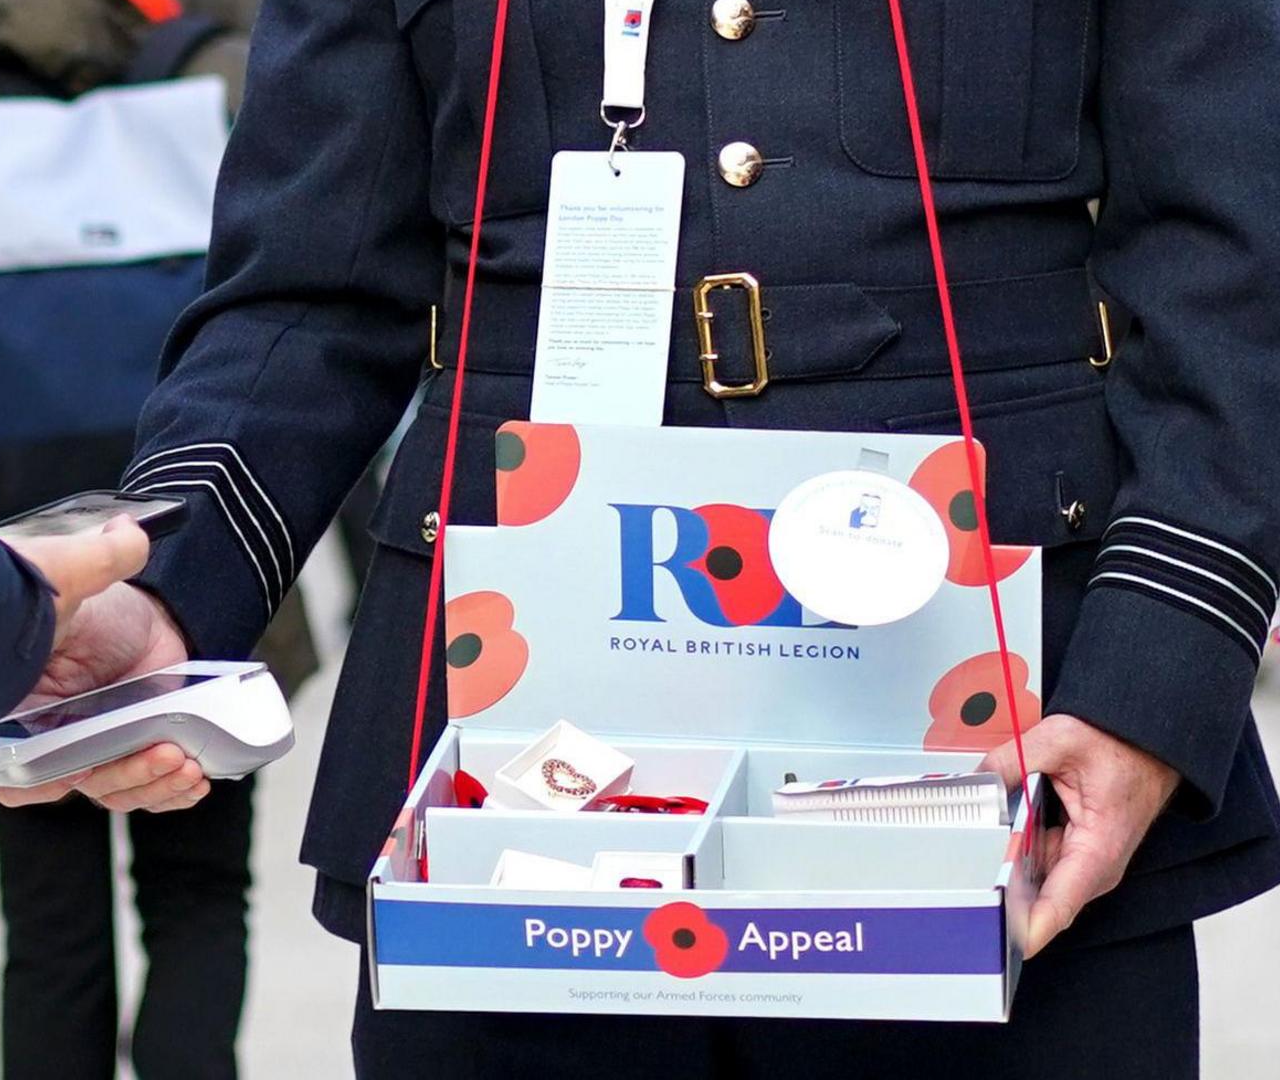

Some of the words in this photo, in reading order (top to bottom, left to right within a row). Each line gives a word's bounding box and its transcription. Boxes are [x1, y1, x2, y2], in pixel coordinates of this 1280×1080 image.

[610, 636, 677, 653] ROYAL
[686, 639, 770, 657] BRITISH
[779, 643, 860, 660] LEGION
[524, 918, 632, 958] Poppy
[738, 922, 864, 961] Appeal
[568, 987, 630, 1001] Supporting
[632, 991, 654, 1000] our
[656, 990, 696, 1001] Armed
[699, 991, 736, 1002] Forces
[740, 993, 803, 1004] community
